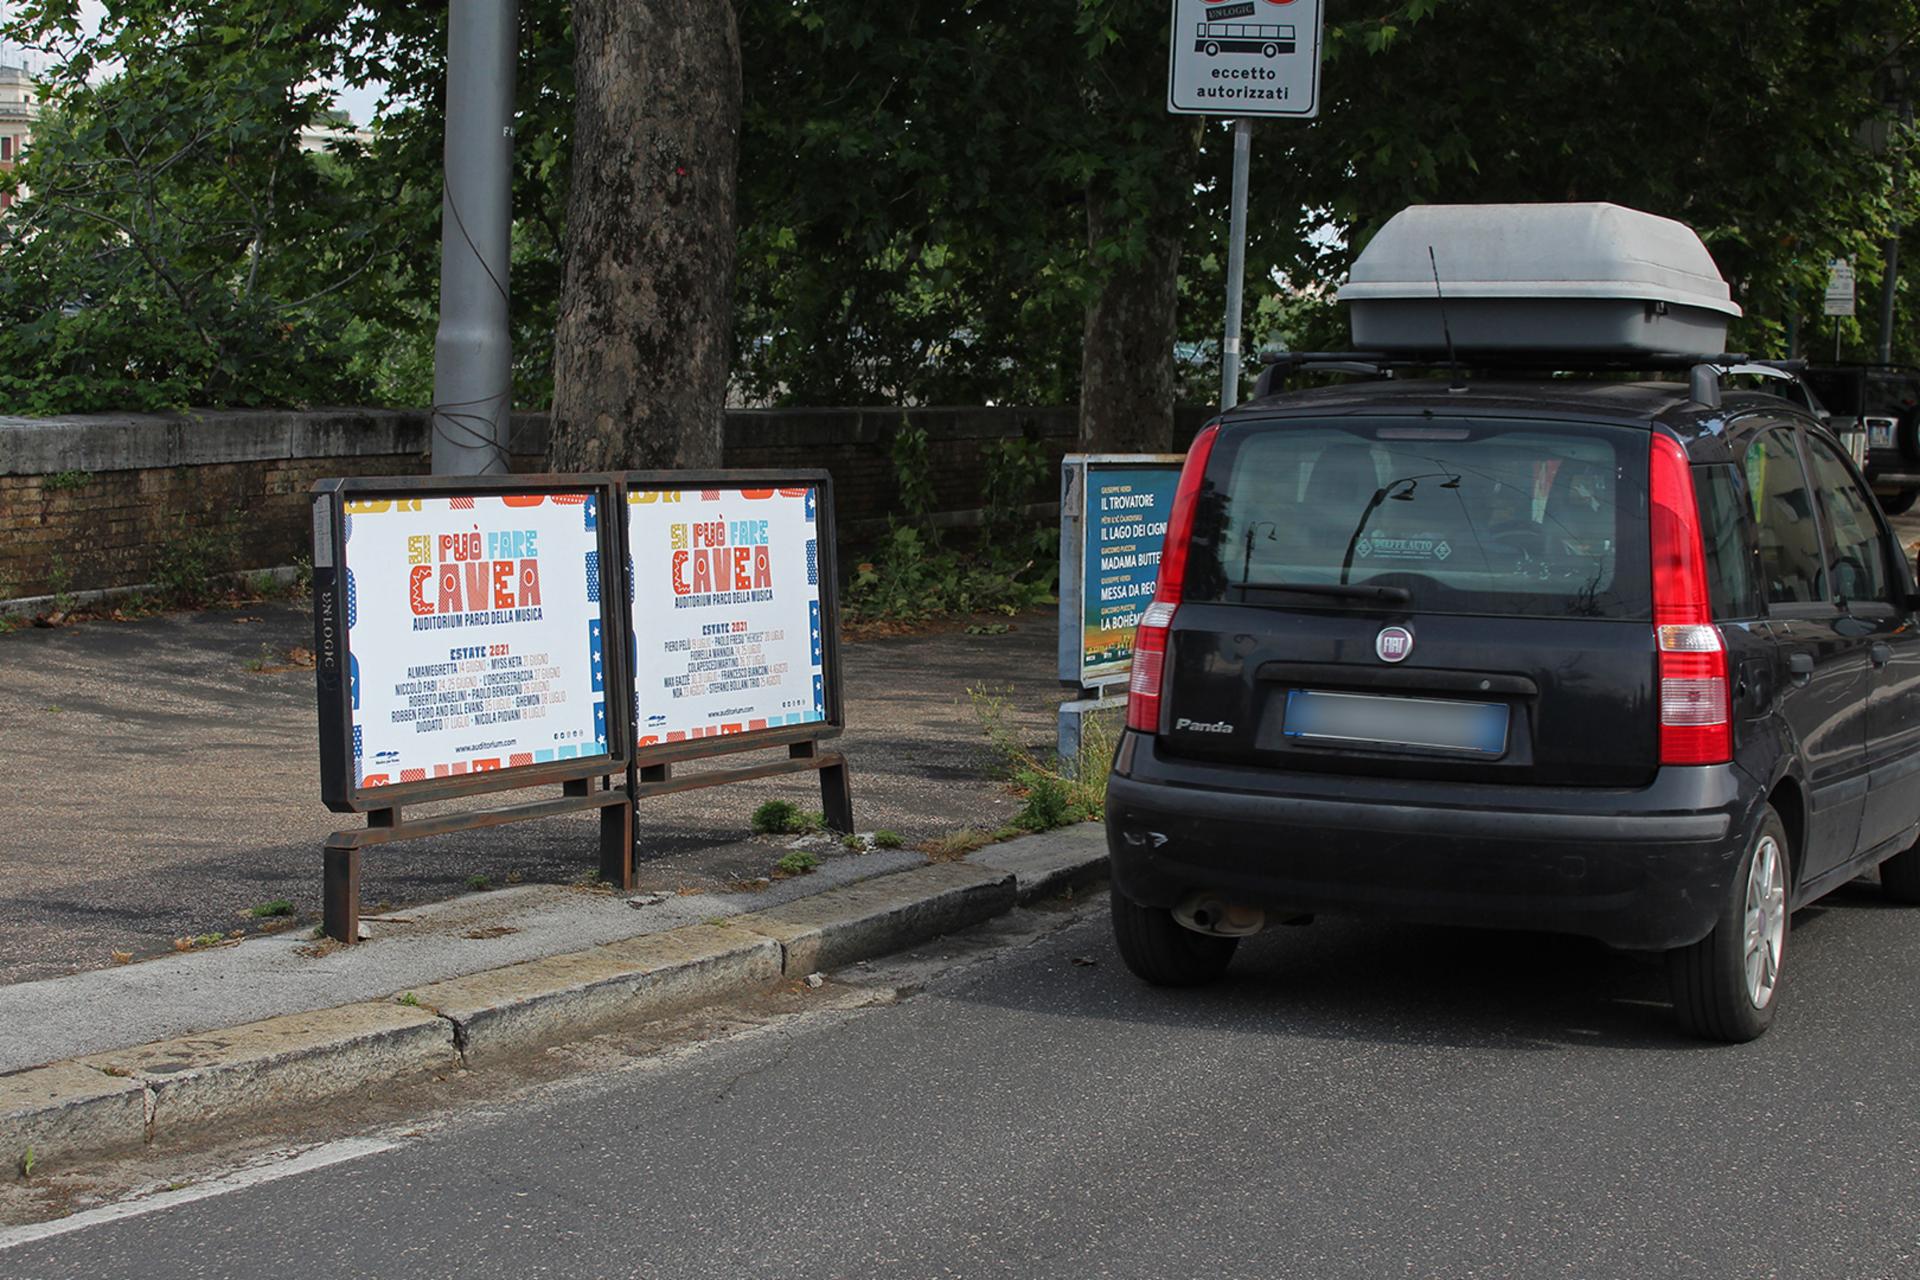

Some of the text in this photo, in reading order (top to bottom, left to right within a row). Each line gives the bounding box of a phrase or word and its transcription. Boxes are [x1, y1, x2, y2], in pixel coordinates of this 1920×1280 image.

[1211, 67, 1276, 80] eccetto
[1197, 85, 1289, 100] autorizzati
[1101, 494, 1154, 510] IL TROVATORE
[670, 514, 768, 550] SI PUÒ FARE
[1101, 522, 1167, 541] IL LAGO DEI CIGN
[408, 523, 538, 564] SI PUÒ FARE
[672, 545, 772, 595] CAVEA
[1101, 551, 1162, 571] MADAMA BUTTE
[409, 558, 541, 615] CAVEA
[1101, 585, 1128, 601] MESSA
[1128, 583, 1140, 597] DA
[674, 589, 773, 609] AUDITORIUM PARCO DELLA MUSICA
[413, 607, 543, 631] AUDITORIUM PARCO DELLA MUSICA
[1101, 611, 1143, 631] LA BOHÈM
[702, 621, 748, 636] ESTATE 2021
[450, 644, 510, 660] ESTATE 2021
[1383, 636, 1405, 654] FIAT
[407, 662, 458, 679] ALMAMEGRETTA
[508, 655, 523, 668] KETA
[423, 680, 438, 693] FABI
[709, 681, 729, 694] STEFANO
[409, 692, 438, 707] ROBERTO
[438, 690, 467, 704] ANGELINI
[472, 686, 492, 700] PAOLO
[391, 707, 417, 723] ROBBEN
[418, 706, 434, 720] FORD
[435, 704, 449, 718] AND
[450, 703, 463, 717] BILL
[464, 701, 484, 715] EVANS
[474, 711, 497, 726] NICOLA
[497, 709, 521, 723] PIOVANI
[1175, 717, 1234, 734] Panda
[455, 738, 517, 753] www.auditorium.com
